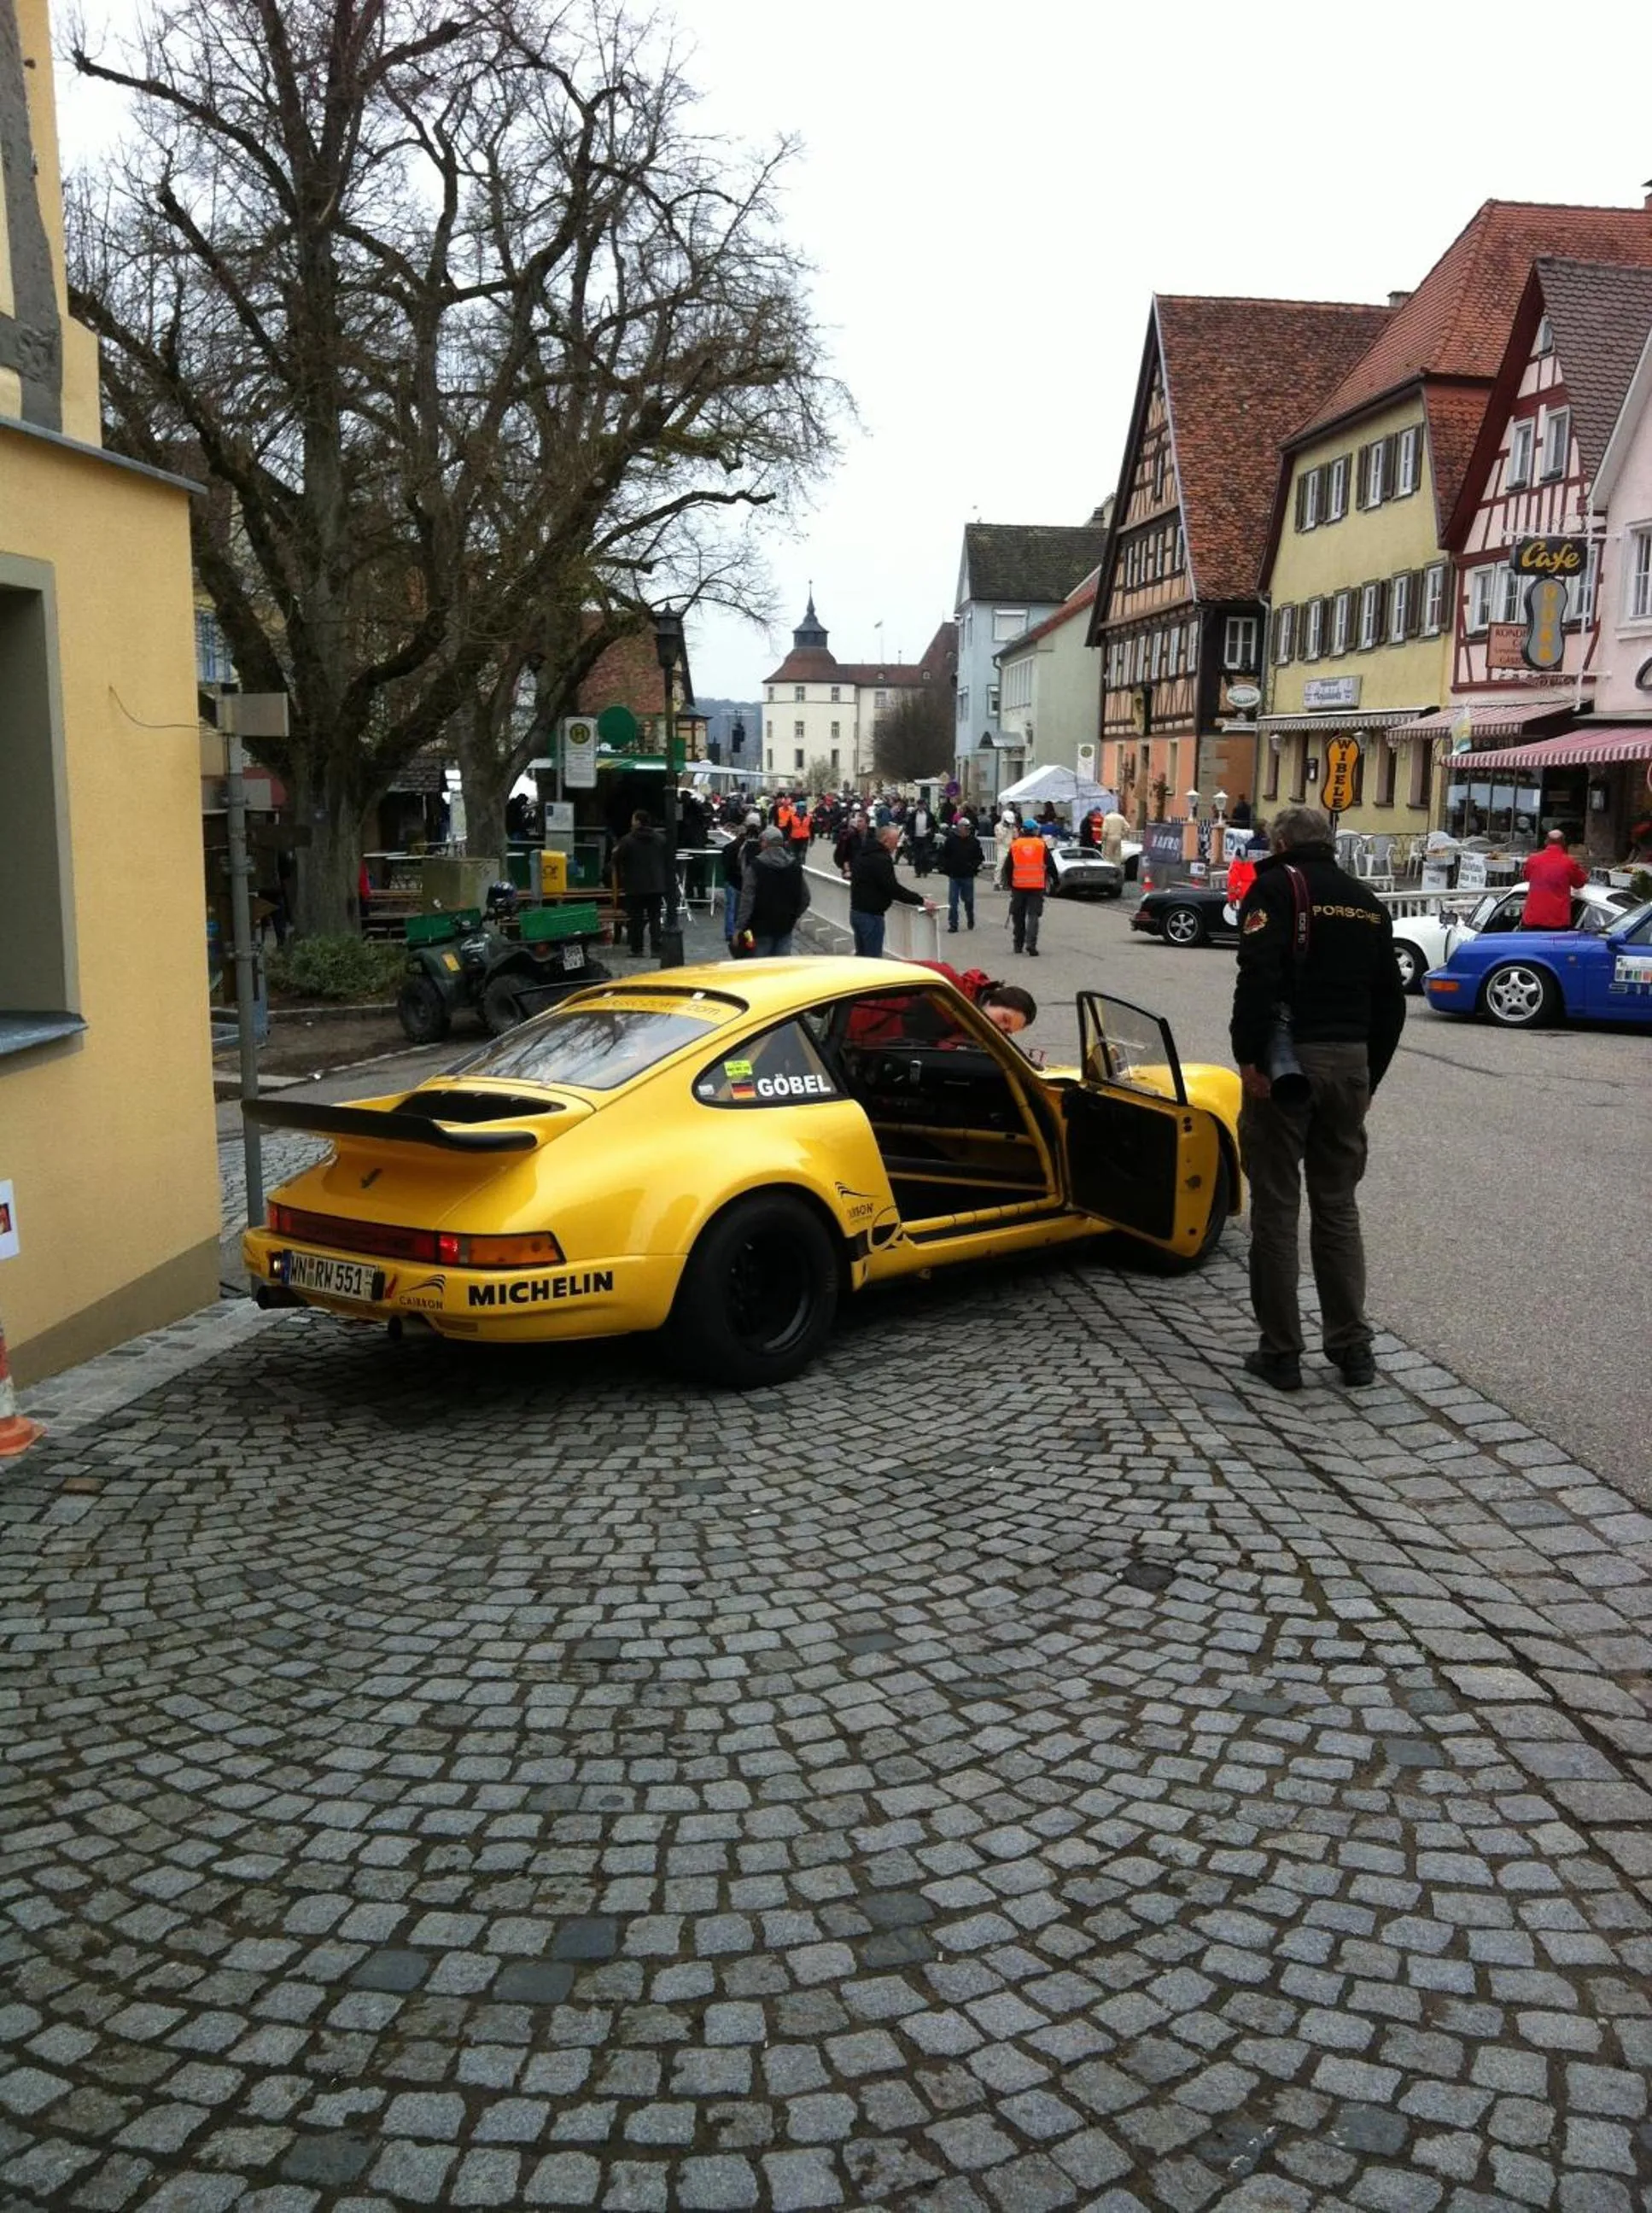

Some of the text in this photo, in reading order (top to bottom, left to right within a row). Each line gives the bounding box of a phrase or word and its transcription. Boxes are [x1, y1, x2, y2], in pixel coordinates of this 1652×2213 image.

[1331, 739, 1351, 809] WIBELE
[1311, 905, 1382, 925] PORSCHE
[756, 1073, 832, 1097] GÖBEL
[336, 1265, 363, 1294] 551
[468, 1270, 613, 1306] MICHELIN
